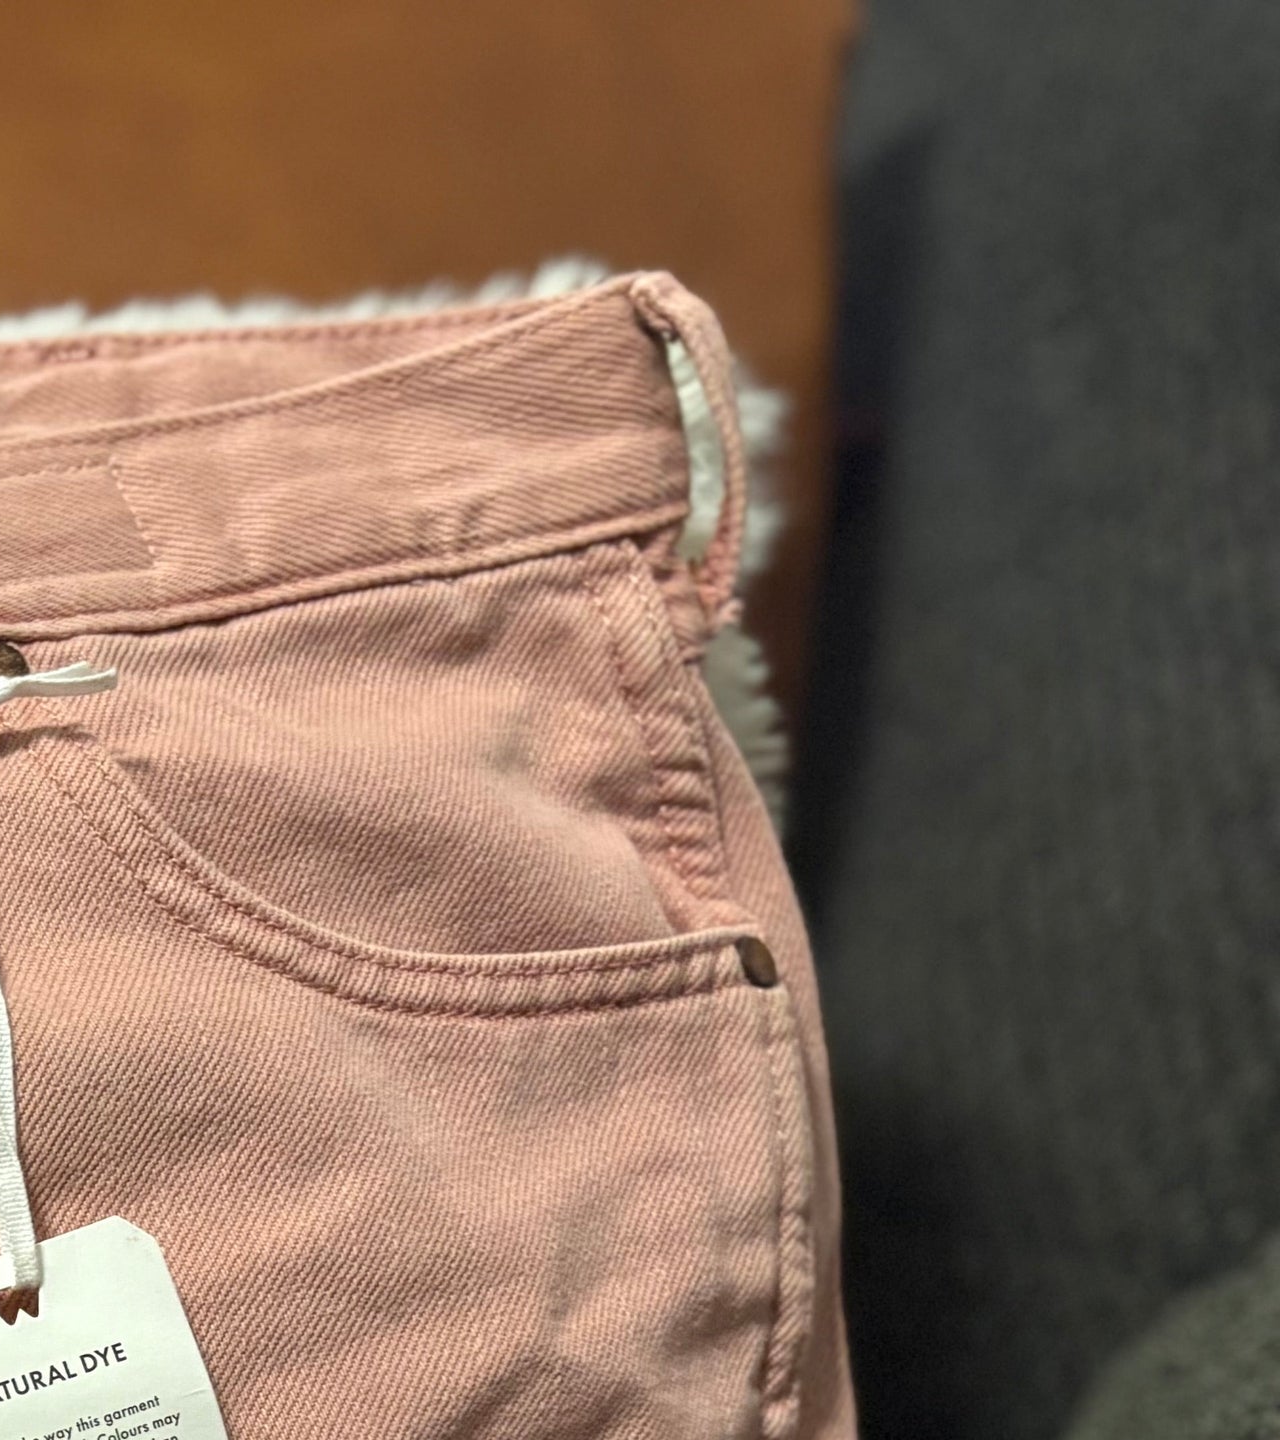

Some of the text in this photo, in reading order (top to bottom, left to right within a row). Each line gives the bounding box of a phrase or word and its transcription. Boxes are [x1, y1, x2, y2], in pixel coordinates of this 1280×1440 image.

[78, 1342, 128, 1374] DYE
[75, 1415, 101, 1433] this
[103, 1395, 160, 1427] garment
[151, 1412, 181, 1430] may
